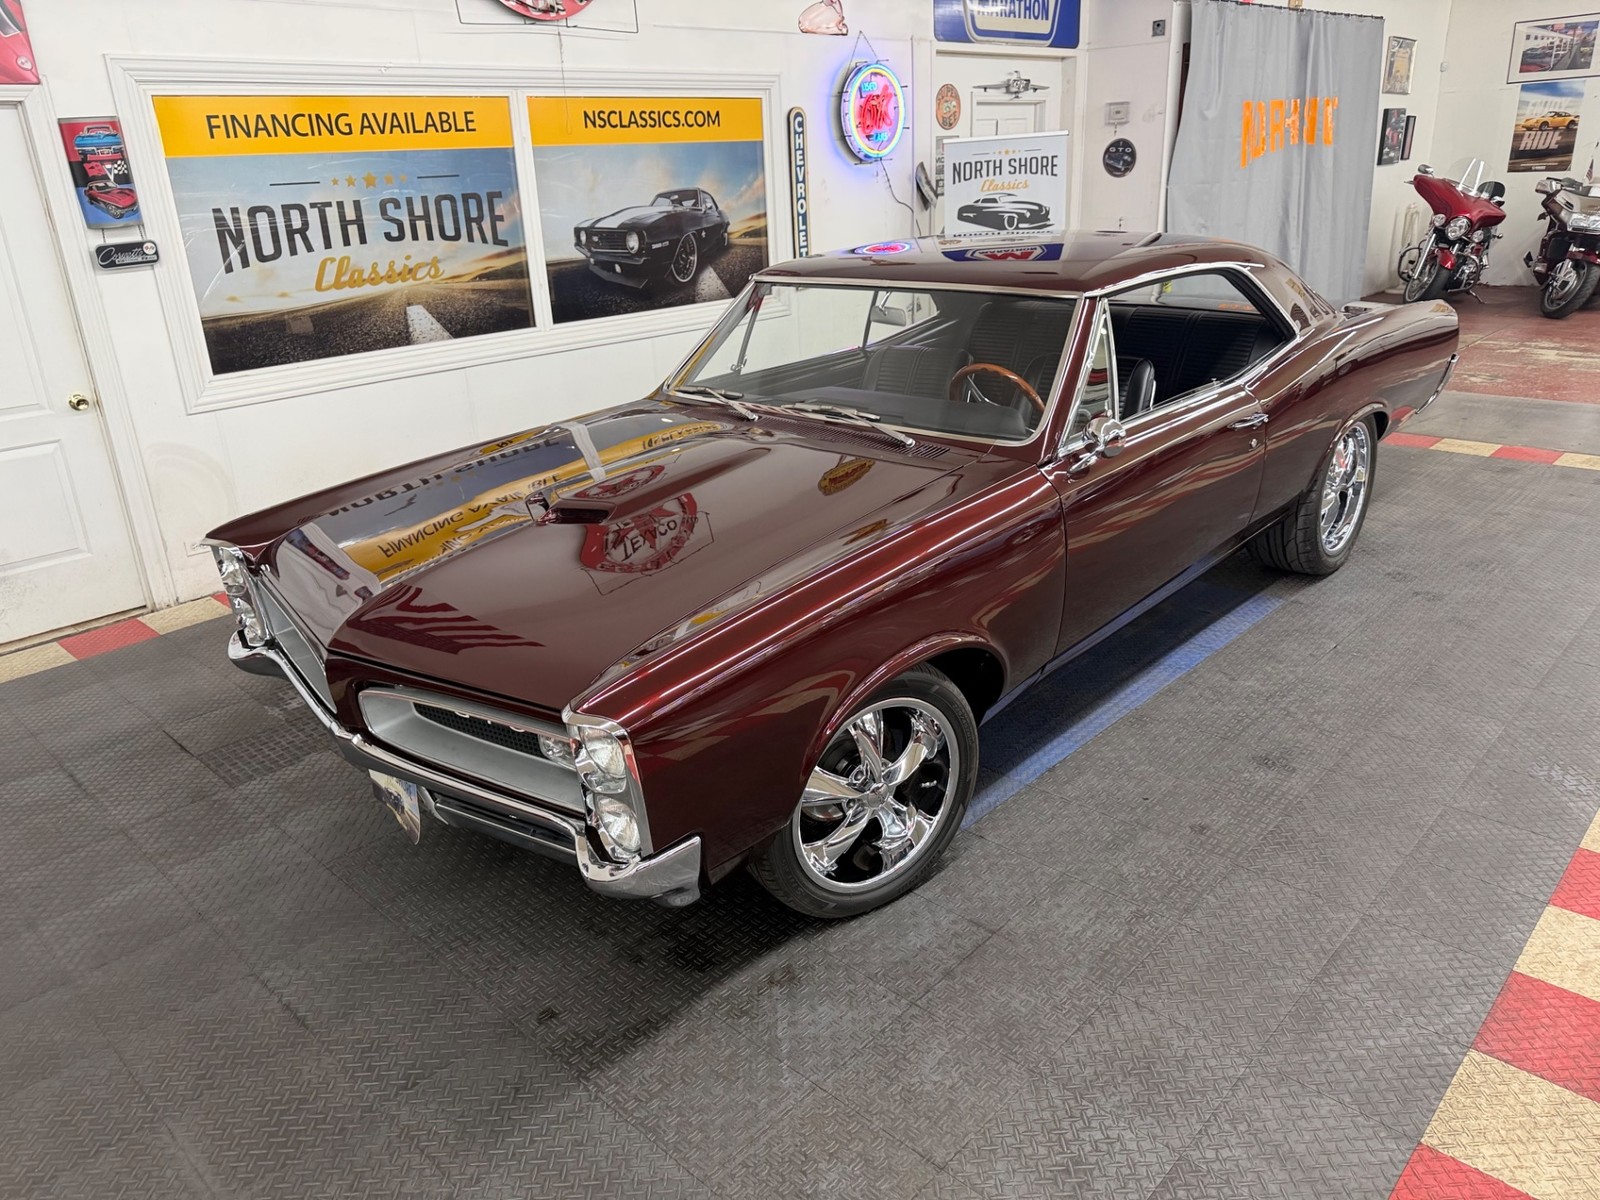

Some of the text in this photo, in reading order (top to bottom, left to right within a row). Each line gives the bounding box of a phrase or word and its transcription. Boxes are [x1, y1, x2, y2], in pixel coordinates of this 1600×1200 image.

[206, 110, 477, 140] FINANCING AVAILABLE
[583, 109, 721, 130] NSCLASSICS.COM
[1519, 130, 1562, 150] RIDE
[952, 158, 1002, 185] NORTH
[1008, 155, 1058, 177] SHORE
[794, 116, 809, 258] CHEVROLET
[980, 178, 1030, 193] Classics
[212, 190, 509, 275] NORTH SHORE
[314, 253, 446, 293] Classics
